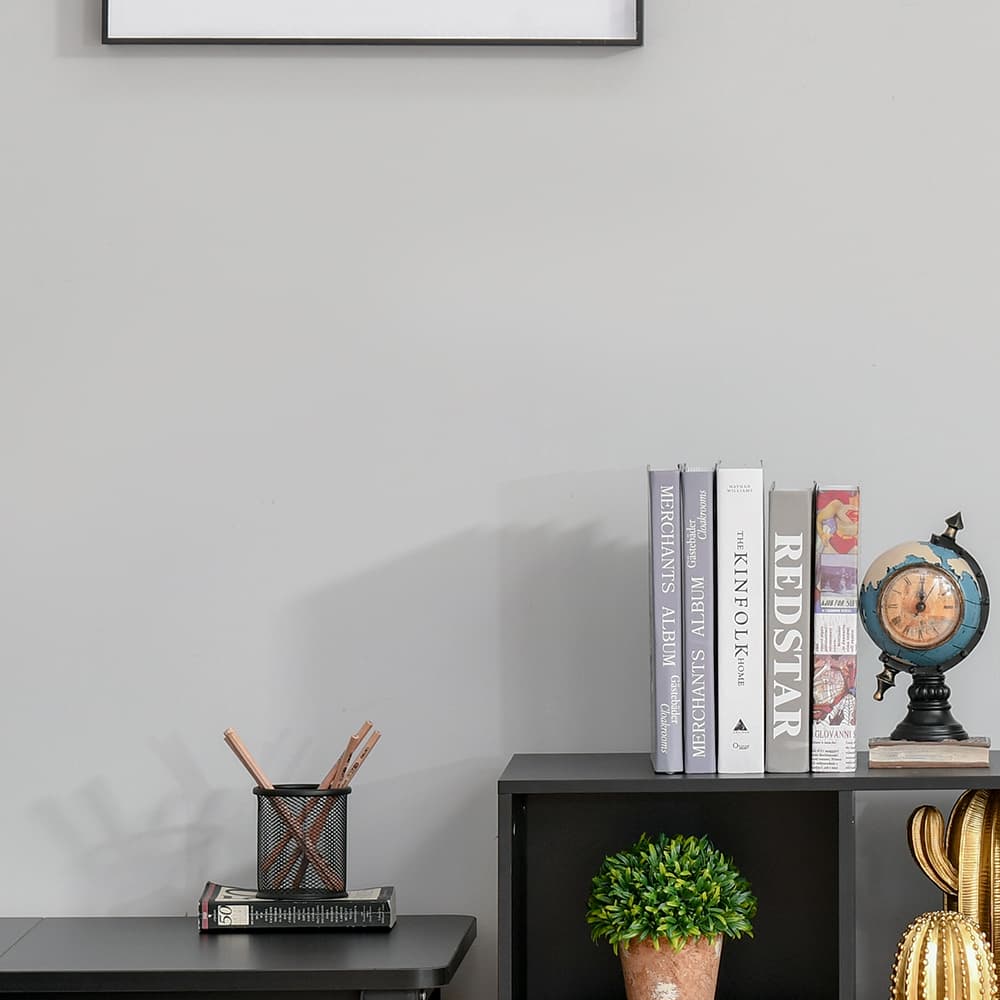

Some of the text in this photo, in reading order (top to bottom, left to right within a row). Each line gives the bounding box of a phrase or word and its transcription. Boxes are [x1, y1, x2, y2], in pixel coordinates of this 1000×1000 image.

[660, 485, 676, 666] MERCHANTS ALBUM
[696, 489, 707, 540] Cloakrooms
[690, 576, 706, 758] MERCHANTS ALBUM
[734, 530, 749, 687] THE KINFOLK HOME
[773, 532, 804, 740] REDSTAR
[660, 703, 671, 753] Cloakrooms
[218, 904, 232, 926] 50
